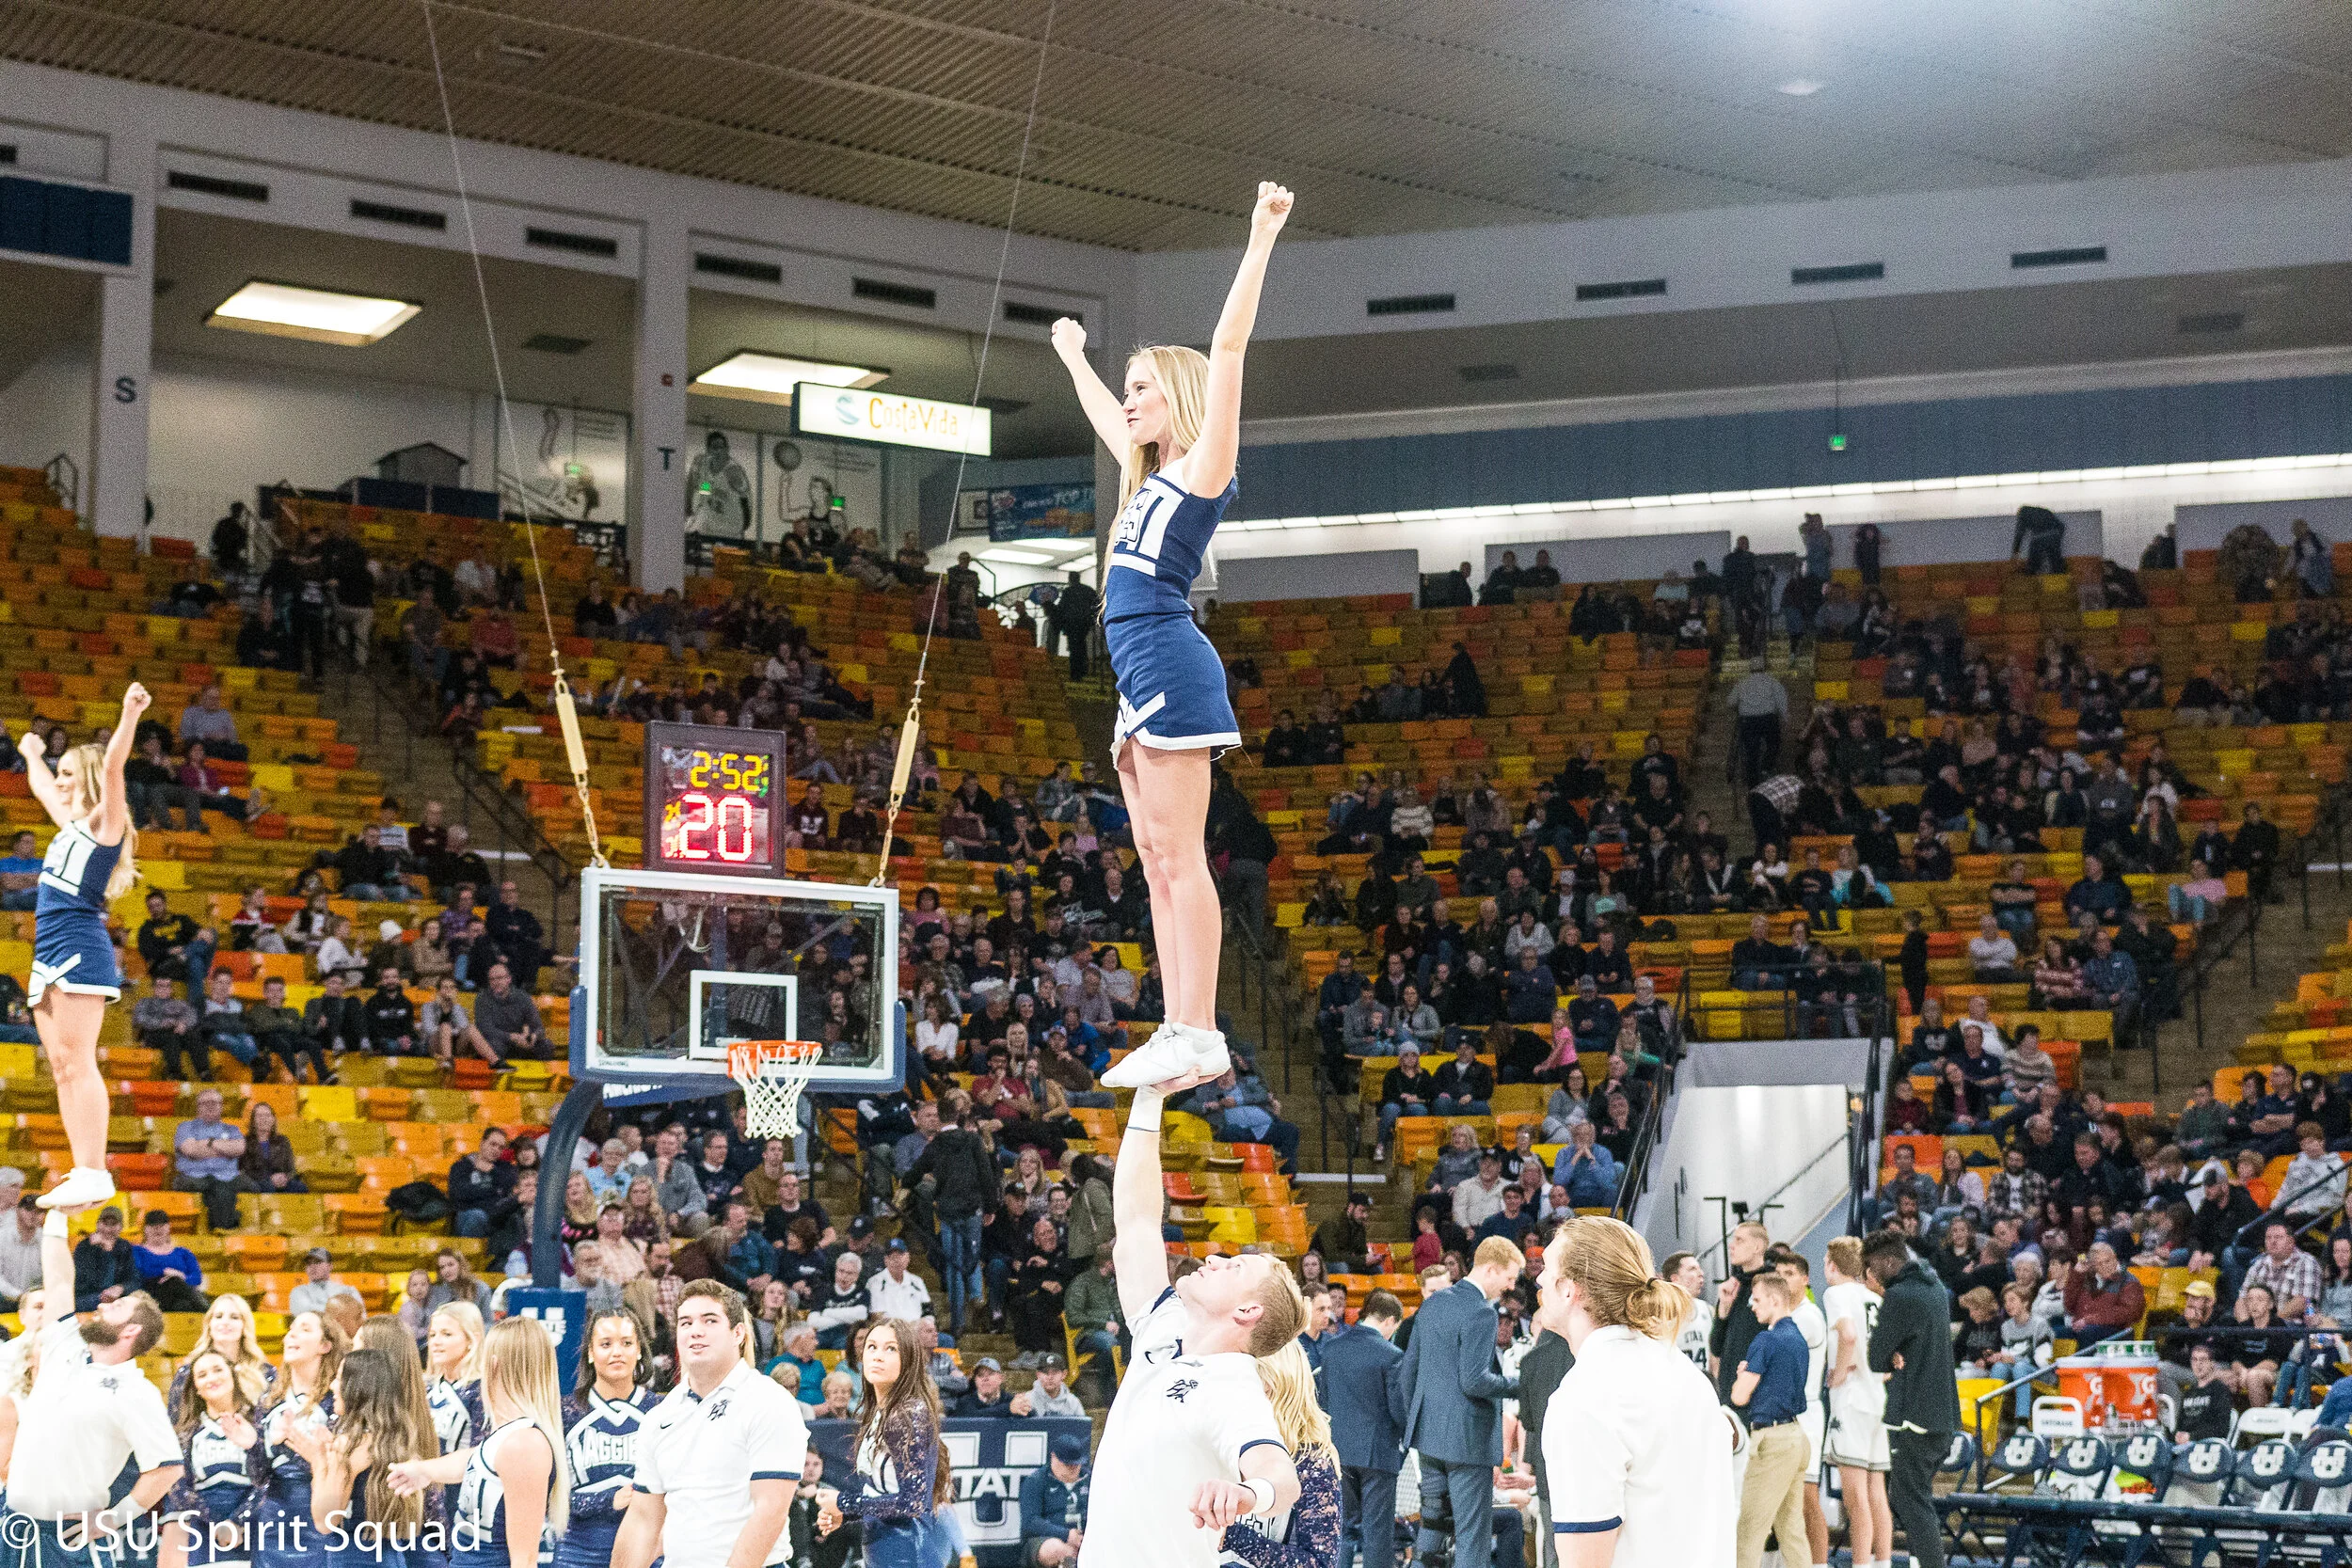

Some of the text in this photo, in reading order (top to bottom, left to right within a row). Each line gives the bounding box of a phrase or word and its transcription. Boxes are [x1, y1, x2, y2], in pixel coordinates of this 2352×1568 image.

[115, 376, 136, 404] S
[658, 447, 676, 470] T
[690, 750, 763, 793] 2:52
[678, 793, 753, 863] 20
